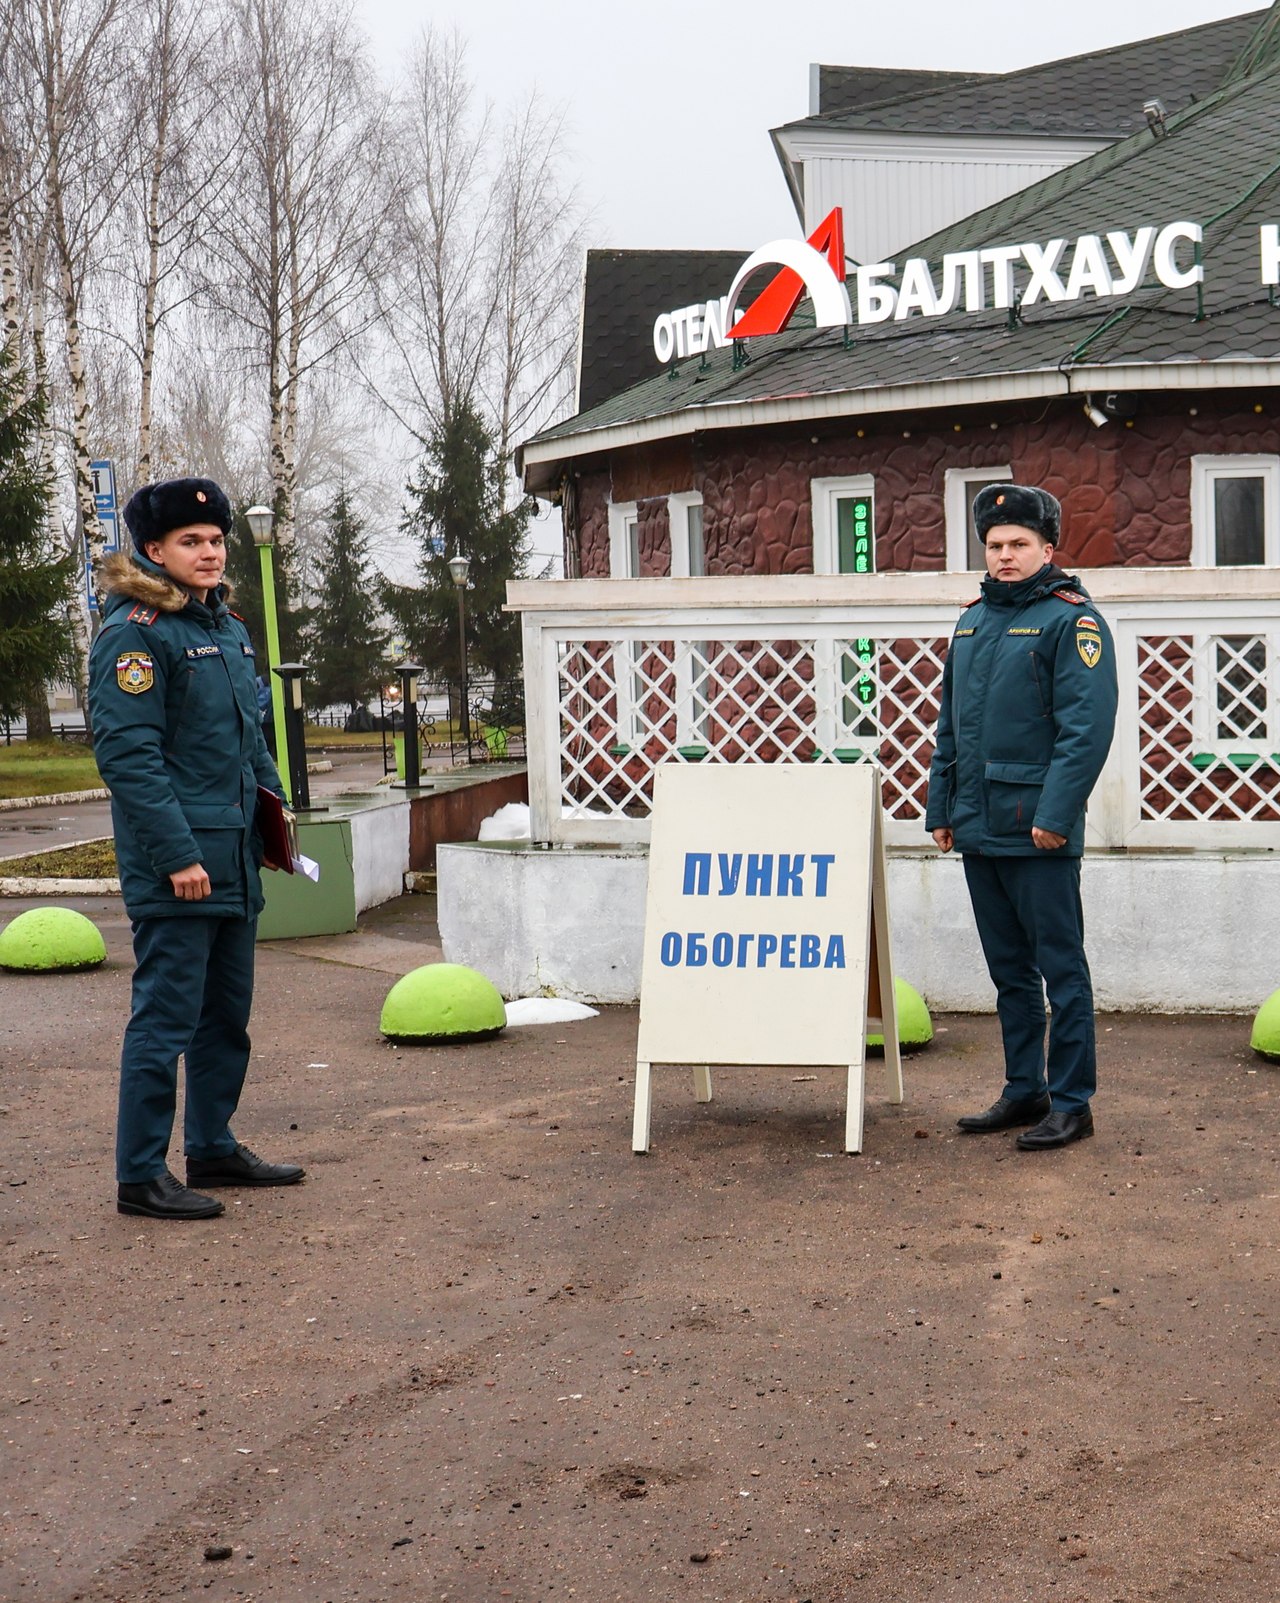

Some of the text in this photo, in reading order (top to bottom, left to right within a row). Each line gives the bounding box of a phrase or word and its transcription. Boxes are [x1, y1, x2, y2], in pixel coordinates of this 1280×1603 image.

[857, 221, 1203, 325] БАЛТХАУС
[196, 646, 220, 655] РОССИИ
[682, 852, 836, 898] ПУНКТ
[660, 931, 847, 969] ОБОГРЕВА
